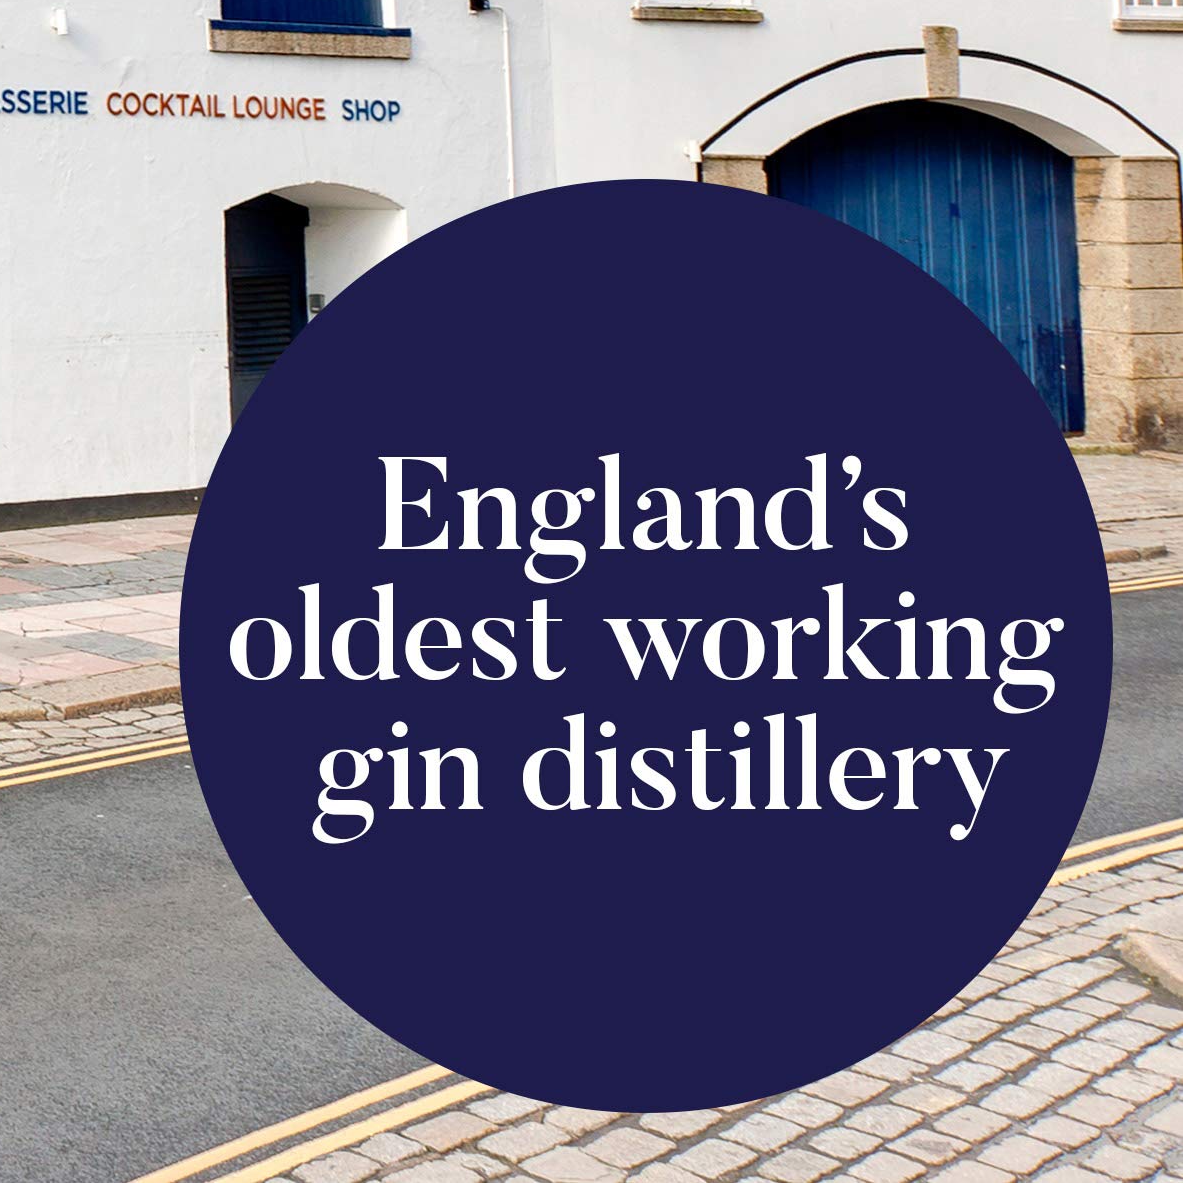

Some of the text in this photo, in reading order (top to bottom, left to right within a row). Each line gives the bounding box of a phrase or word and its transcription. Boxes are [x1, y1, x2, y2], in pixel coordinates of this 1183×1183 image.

[105, 91, 225, 118] COCKTAIL
[231, 96, 326, 122] LOUNGE
[341, 99, 401, 122] SHOP
